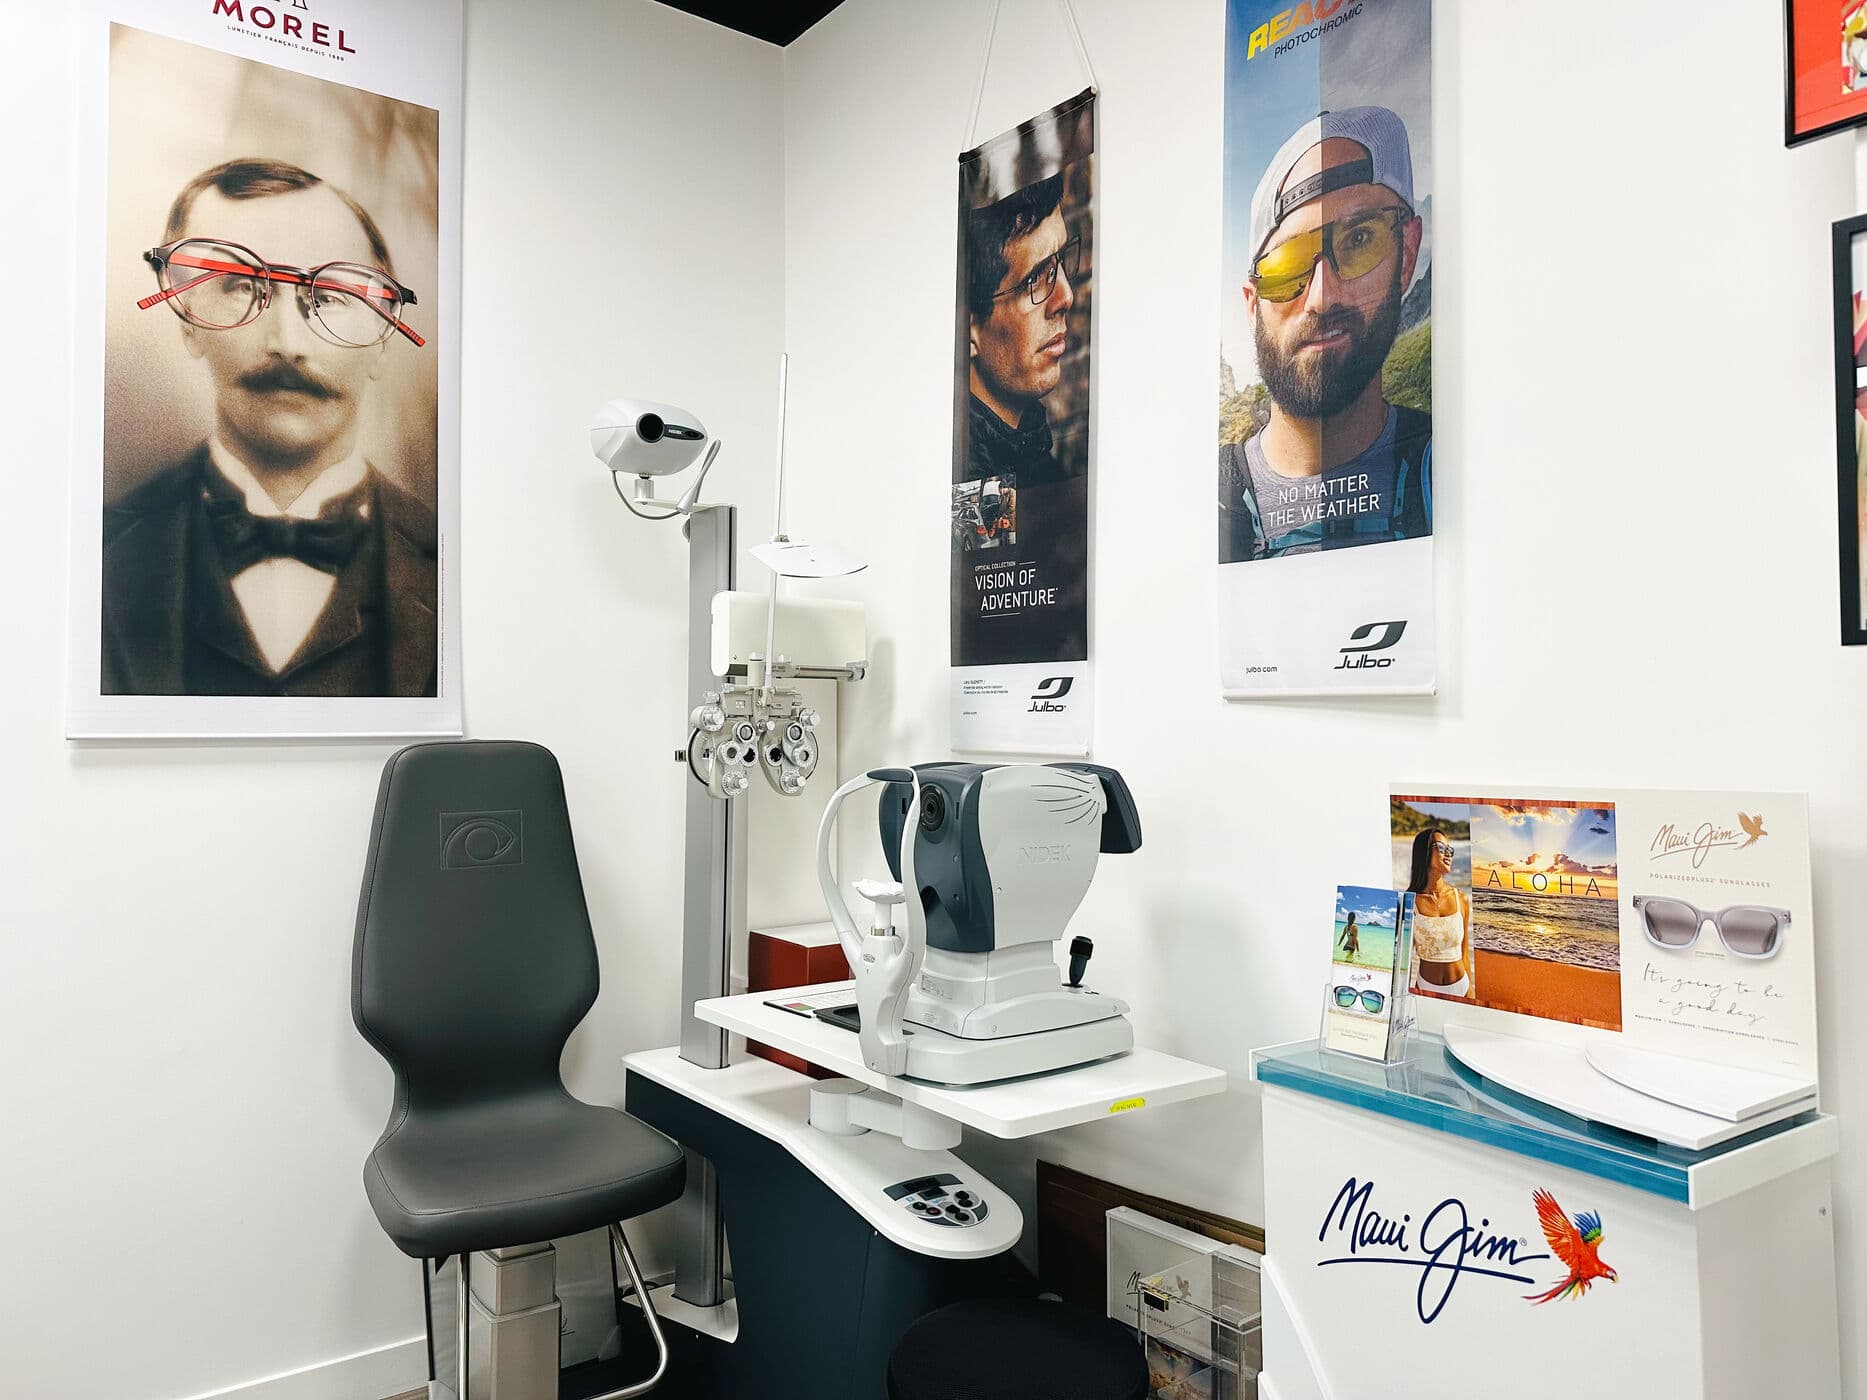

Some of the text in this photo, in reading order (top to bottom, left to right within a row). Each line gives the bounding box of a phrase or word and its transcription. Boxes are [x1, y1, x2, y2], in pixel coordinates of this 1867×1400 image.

[213, 0, 356, 53] MOREL
[1274, 3, 1363, 59] PHOTOCHROMIC
[1279, 474, 1369, 505] NO MATTER
[1268, 495, 1380, 527] THE WEATHER
[975, 568, 1036, 591] VISION OF
[981, 587, 1057, 612] ADVENTURE
[1333, 654, 1392, 669] Julbo
[1027, 701, 1064, 713] Julbo
[1018, 844, 1071, 863] NIDEK
[1650, 822, 1736, 869] Maui Jim
[1487, 869, 1601, 896] ALOHA
[1719, 878, 1771, 888] SUNGLASSES
[1671, 977, 1728, 998] going
[1734, 981, 1753, 994] to
[1763, 985, 1784, 998] be
[1672, 999, 1719, 1015] good
[1726, 1002, 1766, 1025] day
[1318, 1177, 1409, 1254] Maui
